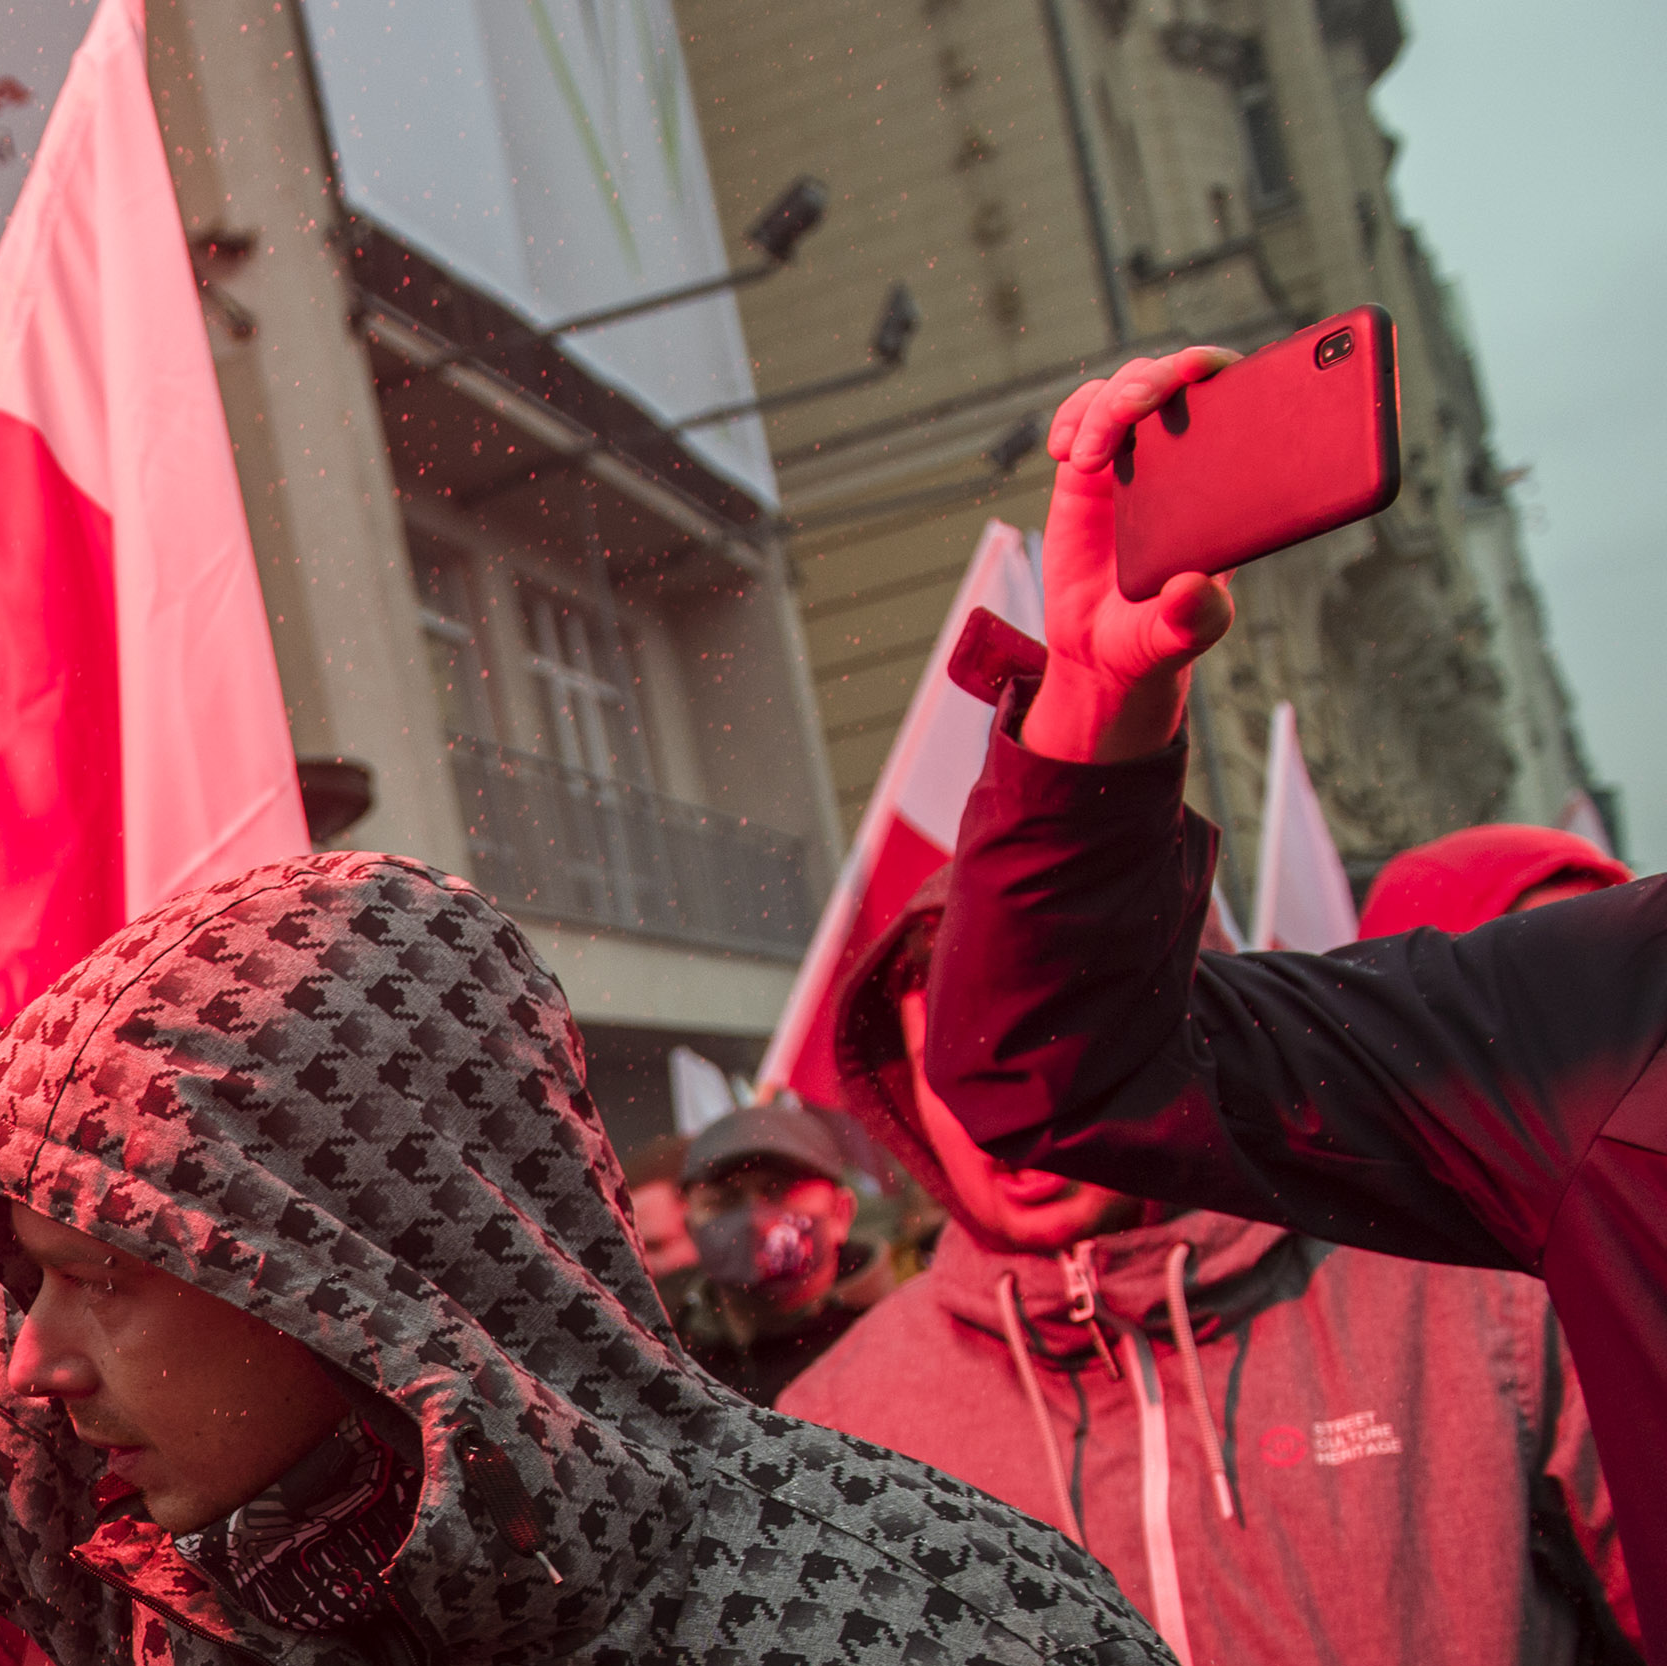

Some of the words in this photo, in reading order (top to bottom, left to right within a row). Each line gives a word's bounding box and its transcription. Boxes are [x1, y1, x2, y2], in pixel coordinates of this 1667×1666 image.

[1313, 1409, 1376, 1435] STREET
[1313, 1422, 1395, 1449] CULTURE
[1315, 1436, 1404, 1466] HERITAGE
